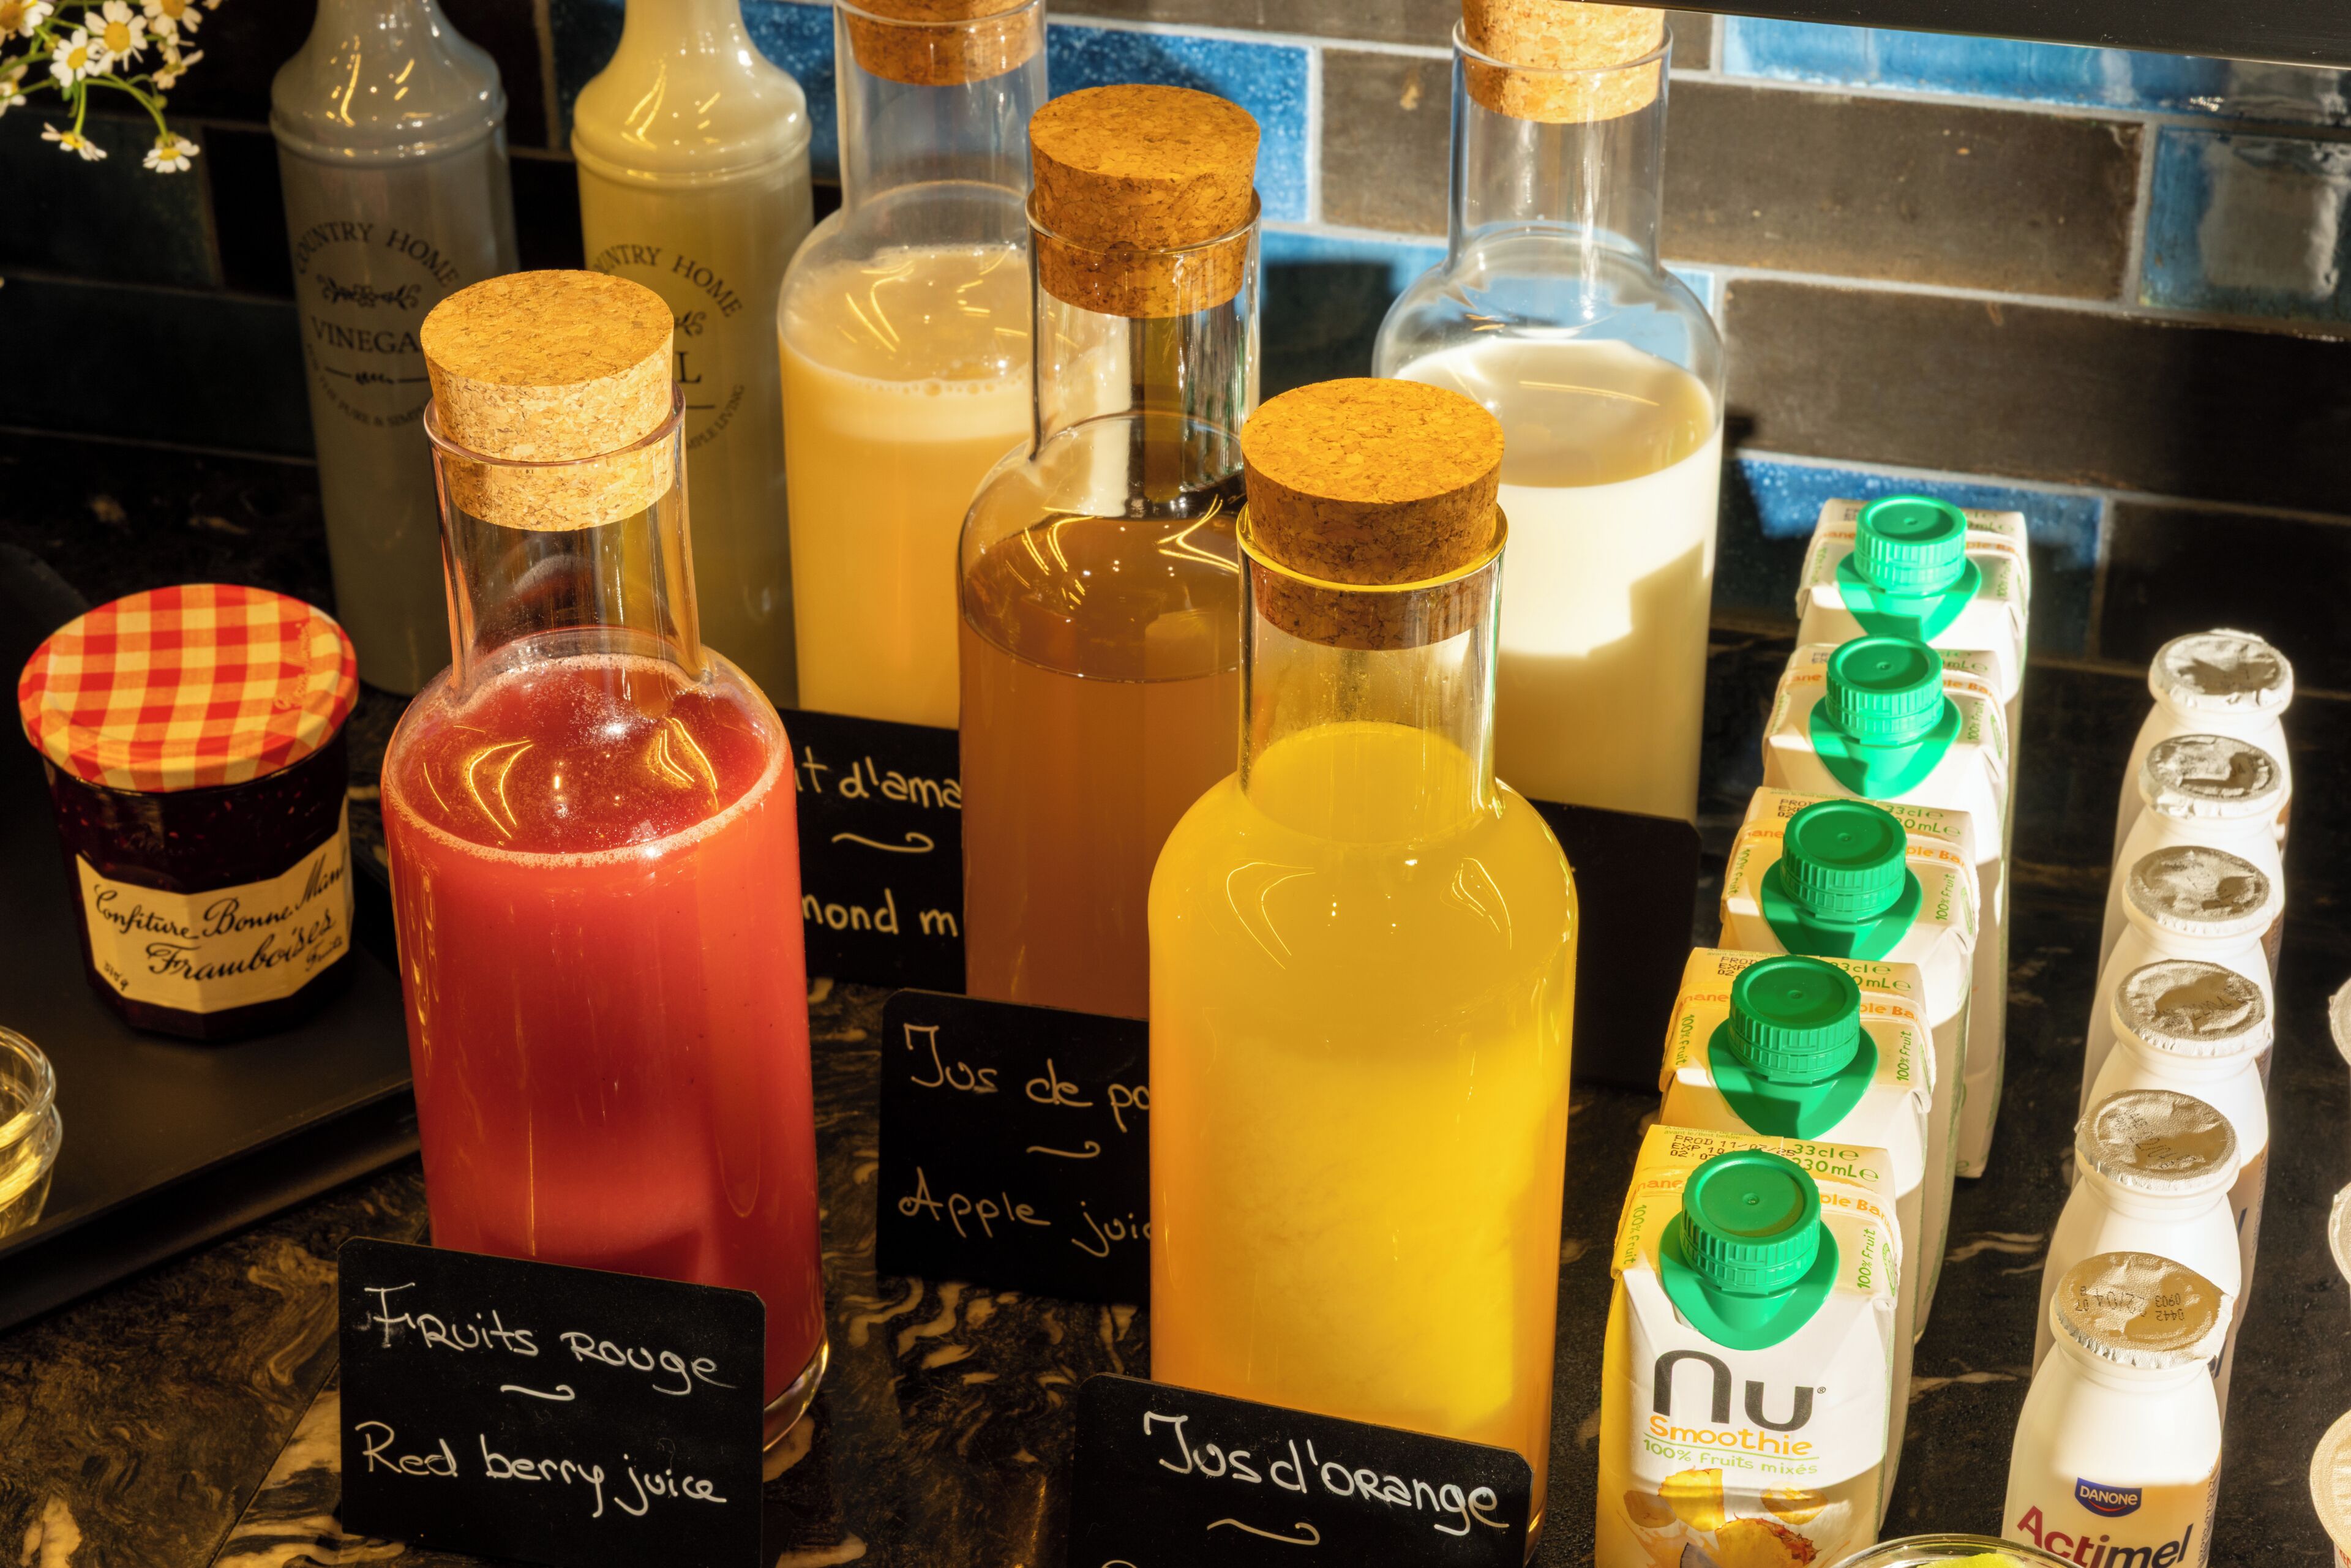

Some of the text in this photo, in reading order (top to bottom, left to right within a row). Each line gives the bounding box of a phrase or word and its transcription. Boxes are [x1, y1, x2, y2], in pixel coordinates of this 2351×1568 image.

[385, 227, 460, 289] HOME
[593, 244, 743, 318] UNTRY HOME
[310, 315, 421, 355] VINEGA
[839, 755, 962, 810] d'ama
[93, 883, 199, 940] Confiture
[202, 896, 294, 938] Bonne
[1935, 898, 1951, 921] 100%
[144, 907, 338, 981] Framboises
[1682, 993, 1730, 1004] nane
[1679, 1014, 1695, 1040] 100%
[1025, 1057, 1094, 1107] de
[1896, 1056, 1911, 1081] 100%
[1671, 1142, 1701, 1151] EXP
[1674, 1135, 1713, 1146] PROD
[1794, 1144, 1835, 1158] 33cl
[898, 1165, 1052, 1239] Apple
[1637, 1179, 1685, 1192] nane
[1629, 1204, 1647, 1234] 100%
[1856, 1259, 1873, 1289] 100%
[1144, 1410, 1262, 1484] Jus
[1649, 1415, 1813, 1456] Smoothie
[355, 1420, 727, 1518] Red berry juice
[1643, 1438, 1692, 1462] 100%
[1761, 1461, 1818, 1476] mixés
[2016, 1504, 2194, 1568] Actimel
